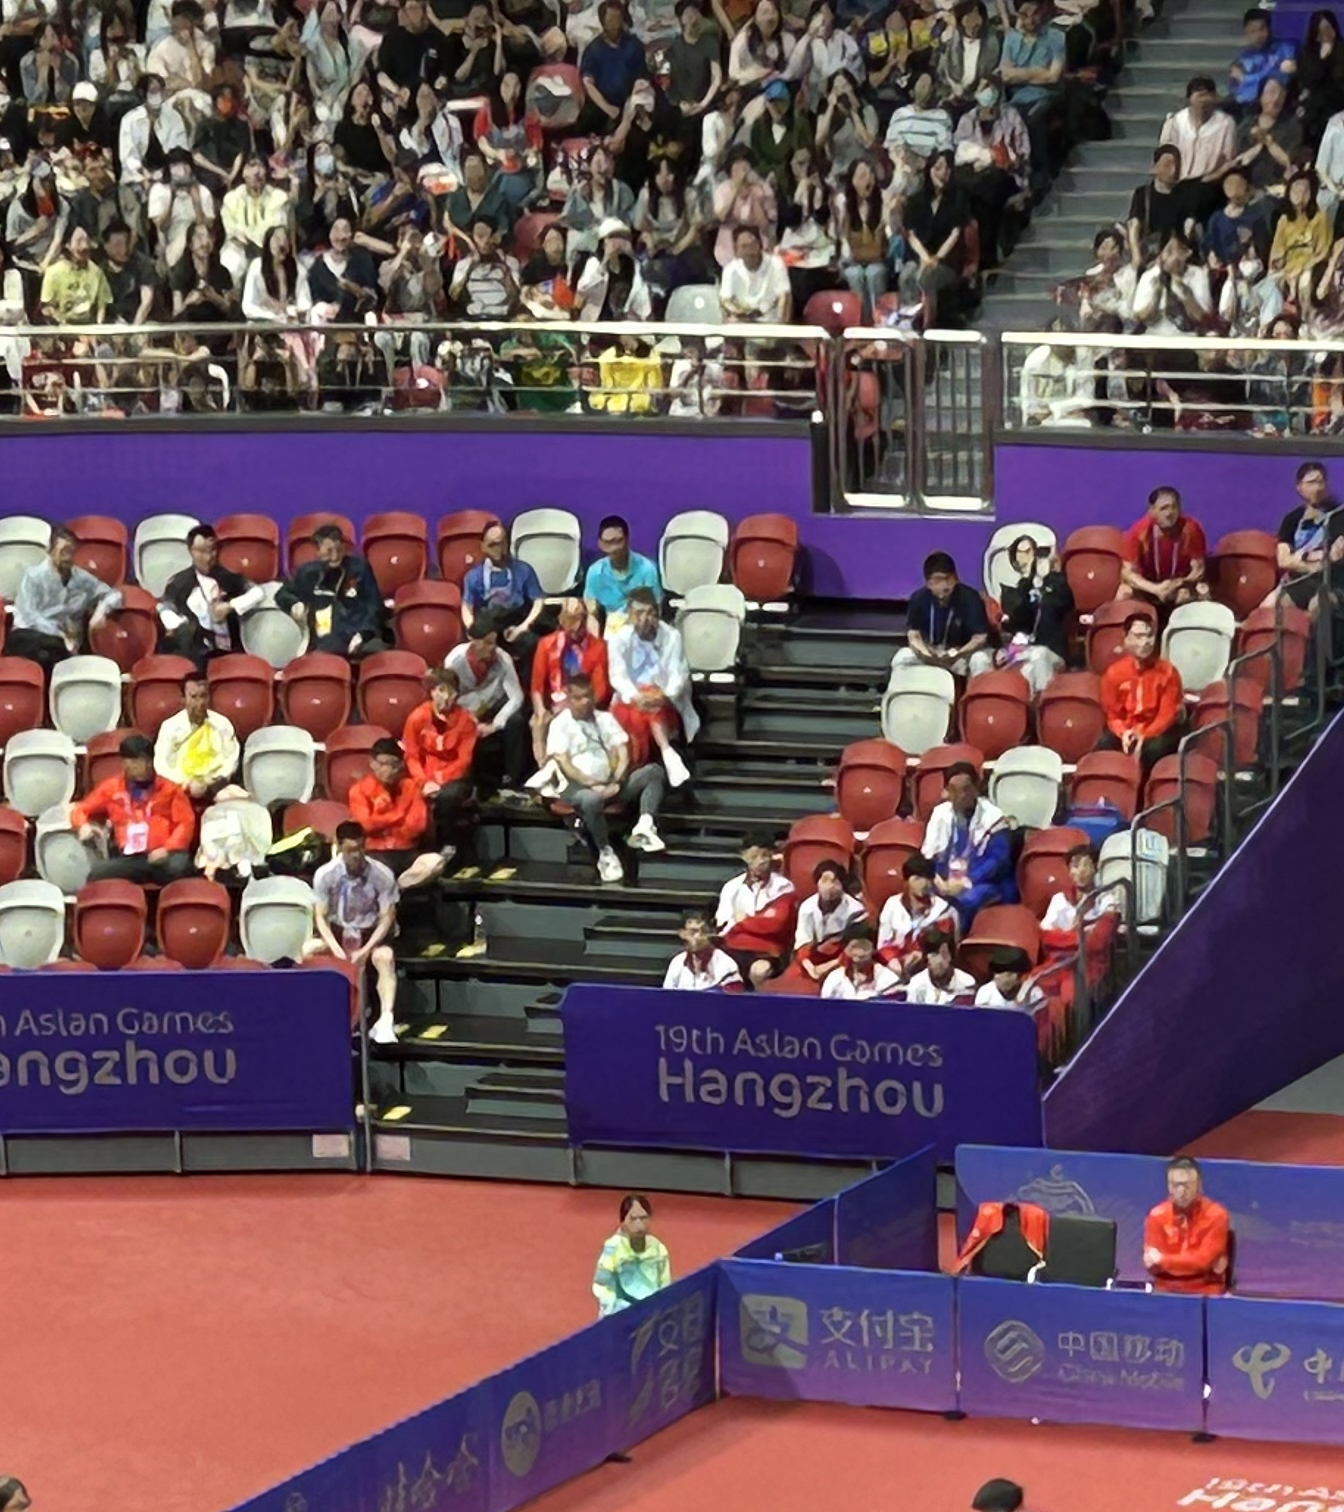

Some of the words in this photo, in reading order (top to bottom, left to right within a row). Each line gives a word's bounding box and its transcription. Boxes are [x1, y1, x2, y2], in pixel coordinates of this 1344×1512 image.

[13, 1009, 109, 1036] Asian
[116, 1007, 235, 1035] Games
[655, 1024, 725, 1055] 19th
[732, 1028, 822, 1060] Asian
[830, 1033, 944, 1067] Games
[657, 1057, 944, 1118] Hangzhou
[819, 1307, 934, 1353] 支付宝
[823, 1350, 934, 1375] ALIPAY
